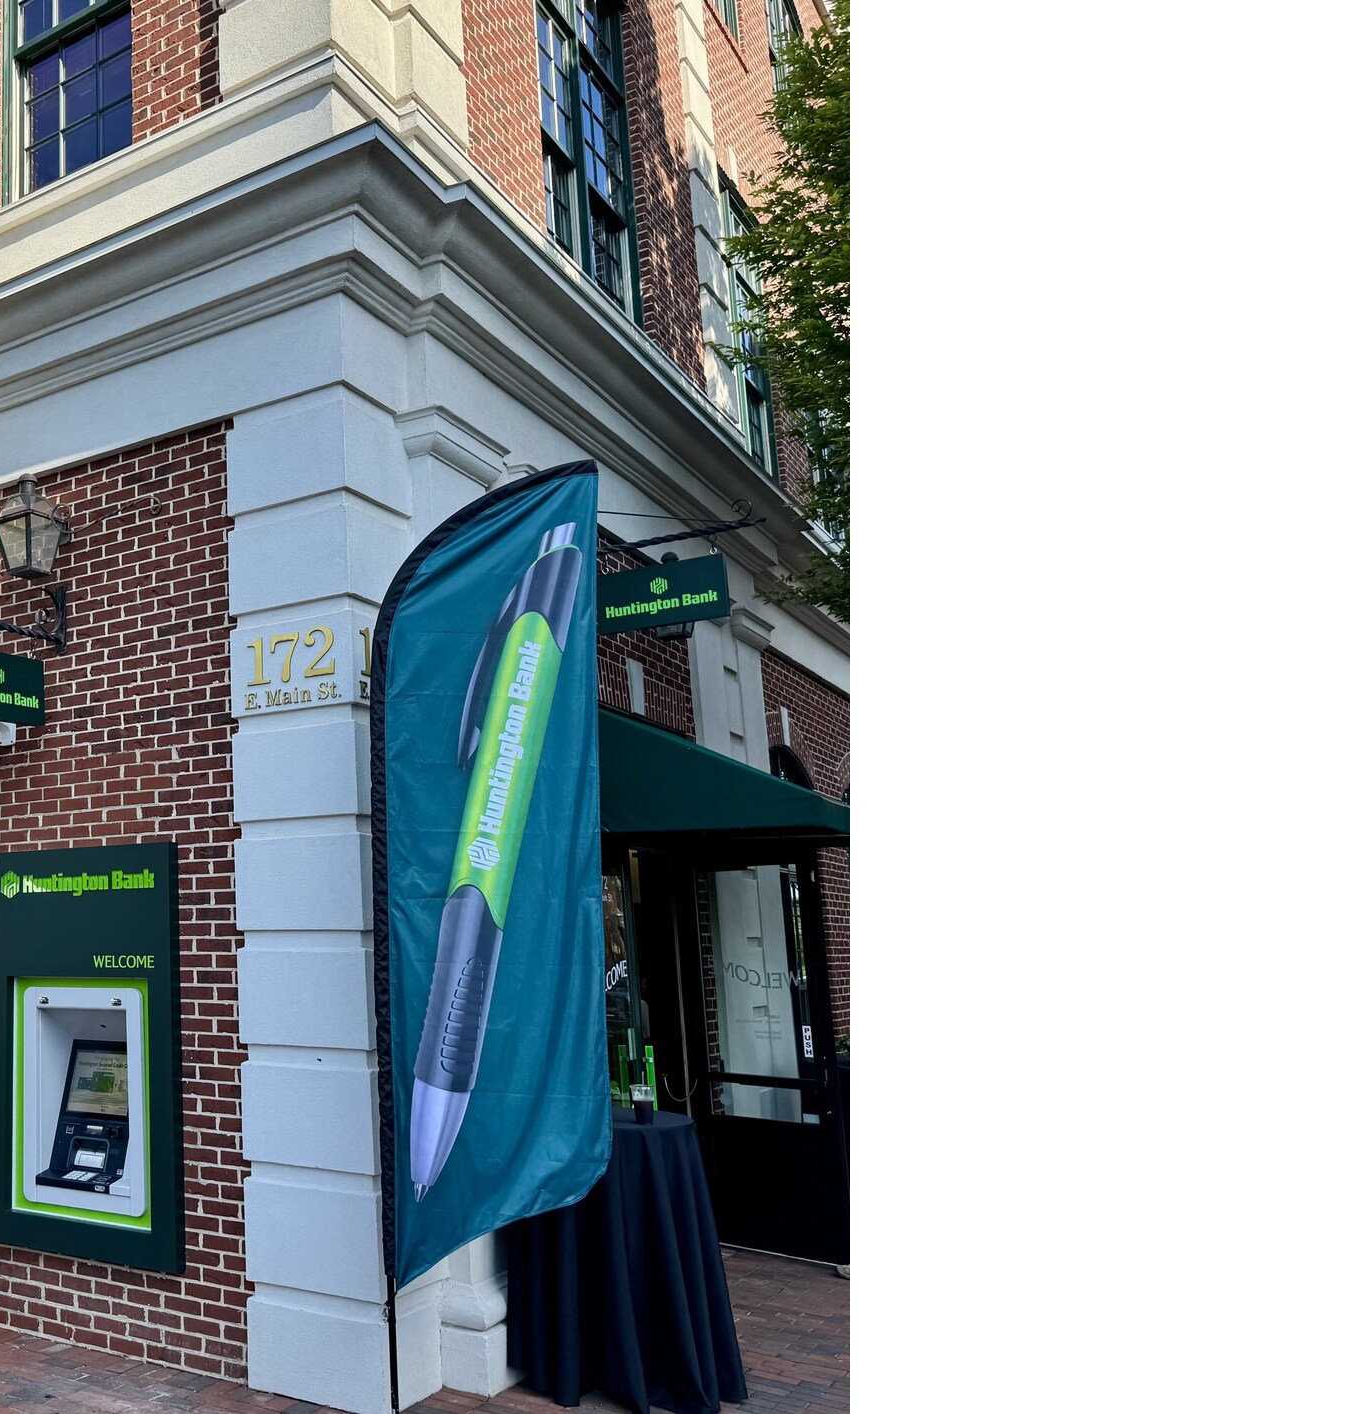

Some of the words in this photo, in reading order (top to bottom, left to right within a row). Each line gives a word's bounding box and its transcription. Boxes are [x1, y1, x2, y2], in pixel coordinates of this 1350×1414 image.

[605, 597, 680, 619] Huntington
[682, 590, 718, 606] Bank
[246, 626, 336, 687] 172
[14, 692, 39, 709] Bank
[244, 692, 262, 710] E.
[265, 686, 312, 708] Main
[318, 681, 342, 700] St.
[478, 704, 527, 835] Huntington
[508, 640, 542, 702] Bank
[22, 871, 108, 897] Huntington
[111, 868, 155, 890] Bank
[93, 955, 155, 969] WELCOME
[605, 960, 628, 991] COME
[804, 1027, 814, 1056] PUSH
